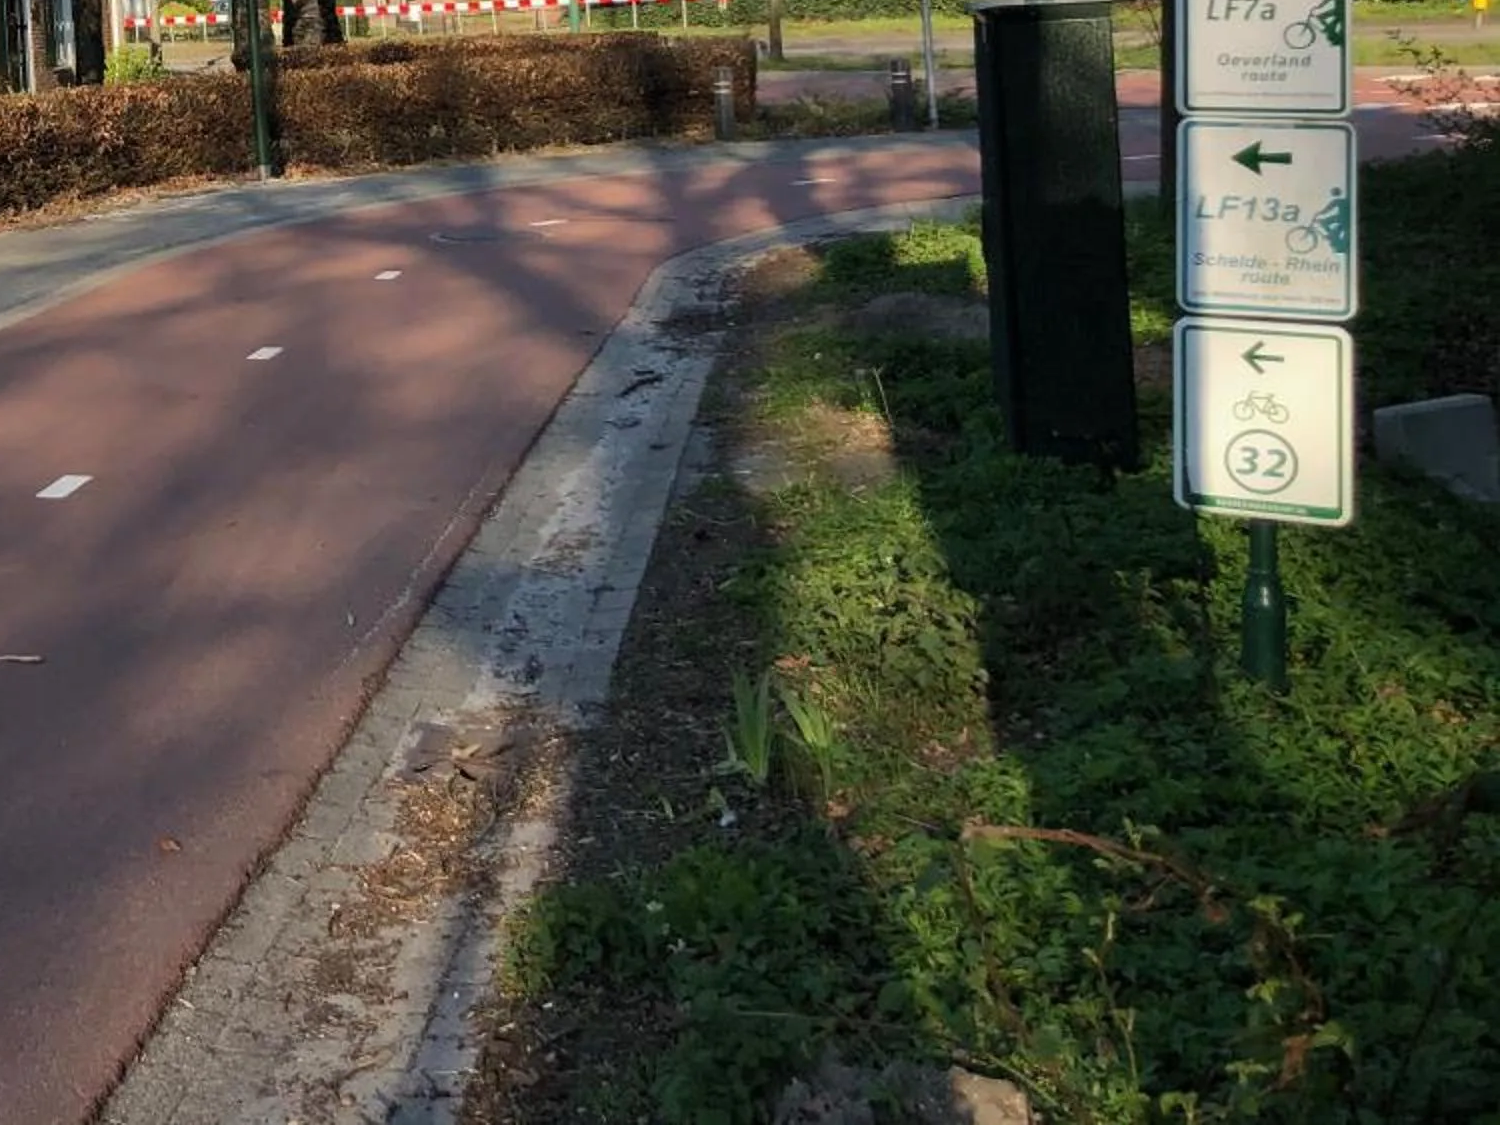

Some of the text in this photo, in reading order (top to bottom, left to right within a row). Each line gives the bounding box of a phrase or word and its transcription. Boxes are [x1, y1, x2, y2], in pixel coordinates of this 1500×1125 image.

[1216, 52, 1312, 68] Oeverland
[1240, 70, 1288, 82] route
[1195, 195, 1301, 222] LF13a
[1285, 255, 1341, 274] Rhein
[1240, 271, 1291, 285] route
[1235, 446, 1288, 478] 32
